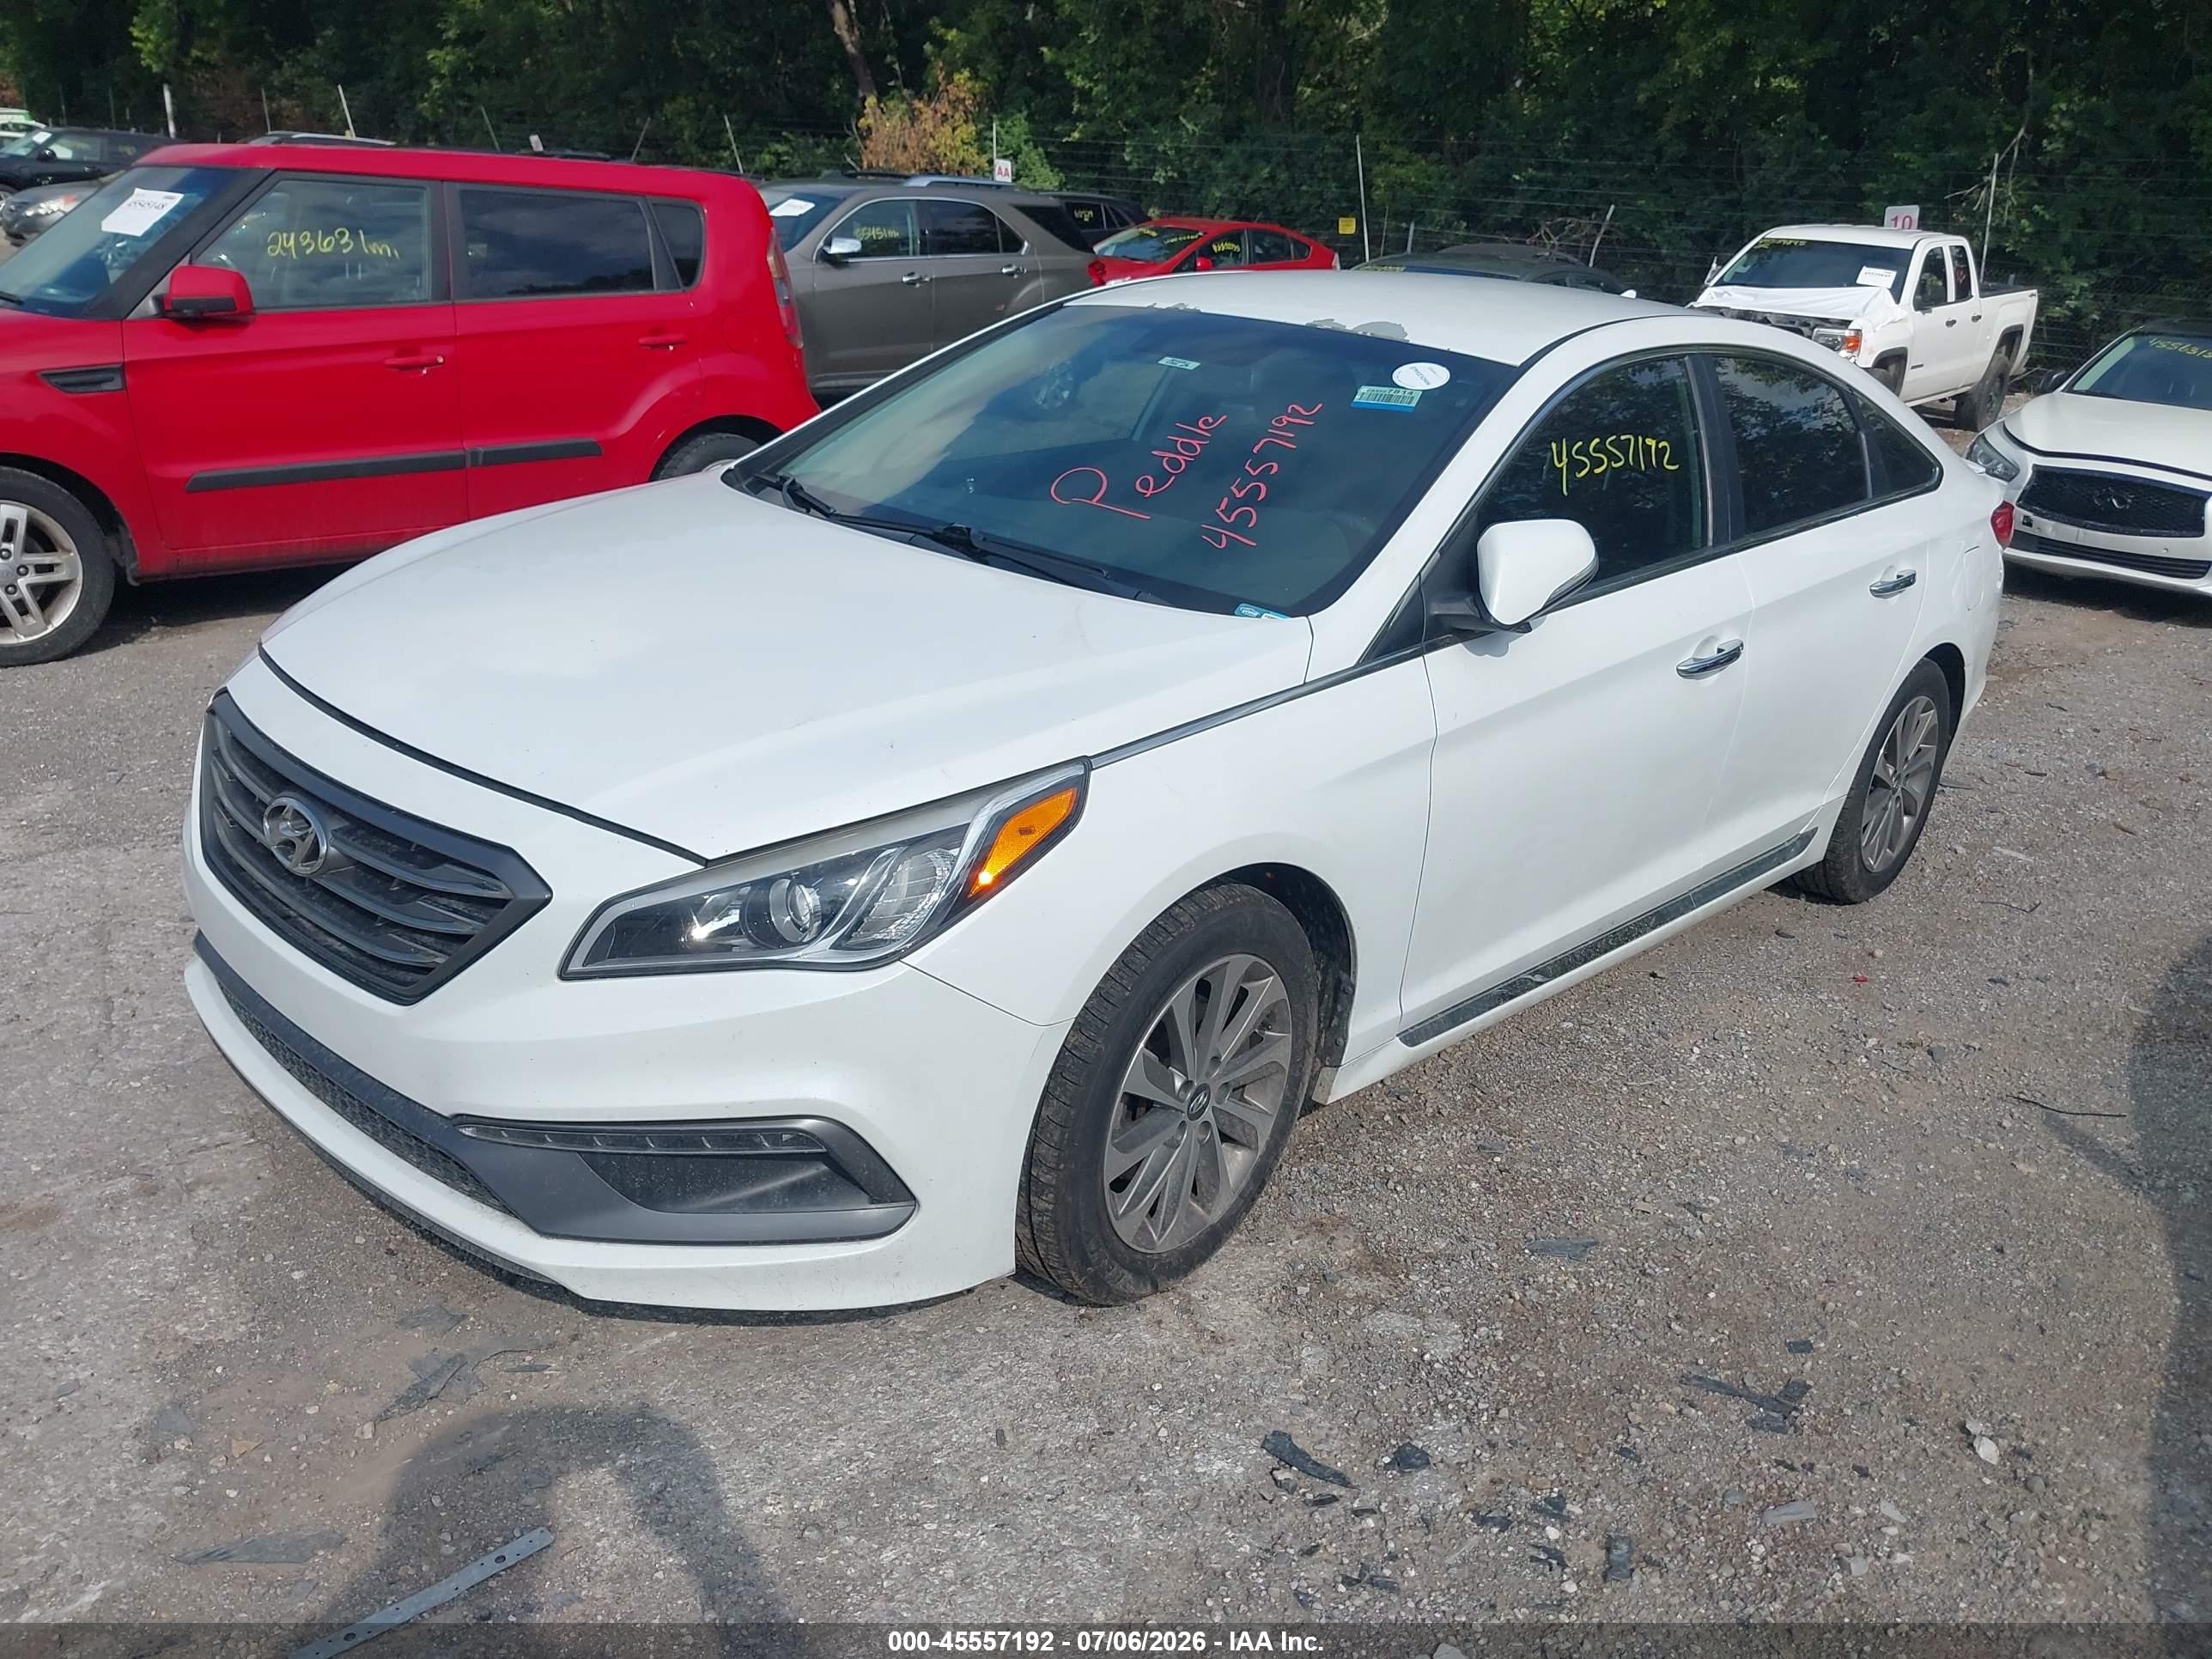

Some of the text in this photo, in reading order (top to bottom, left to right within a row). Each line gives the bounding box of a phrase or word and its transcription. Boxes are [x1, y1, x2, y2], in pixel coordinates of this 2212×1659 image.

[1891, 215, 1913, 229] 10
[1049, 414, 1229, 520] Peddle
[1200, 402, 1324, 550] 45557192
[1551, 434, 1680, 497] 45557192
